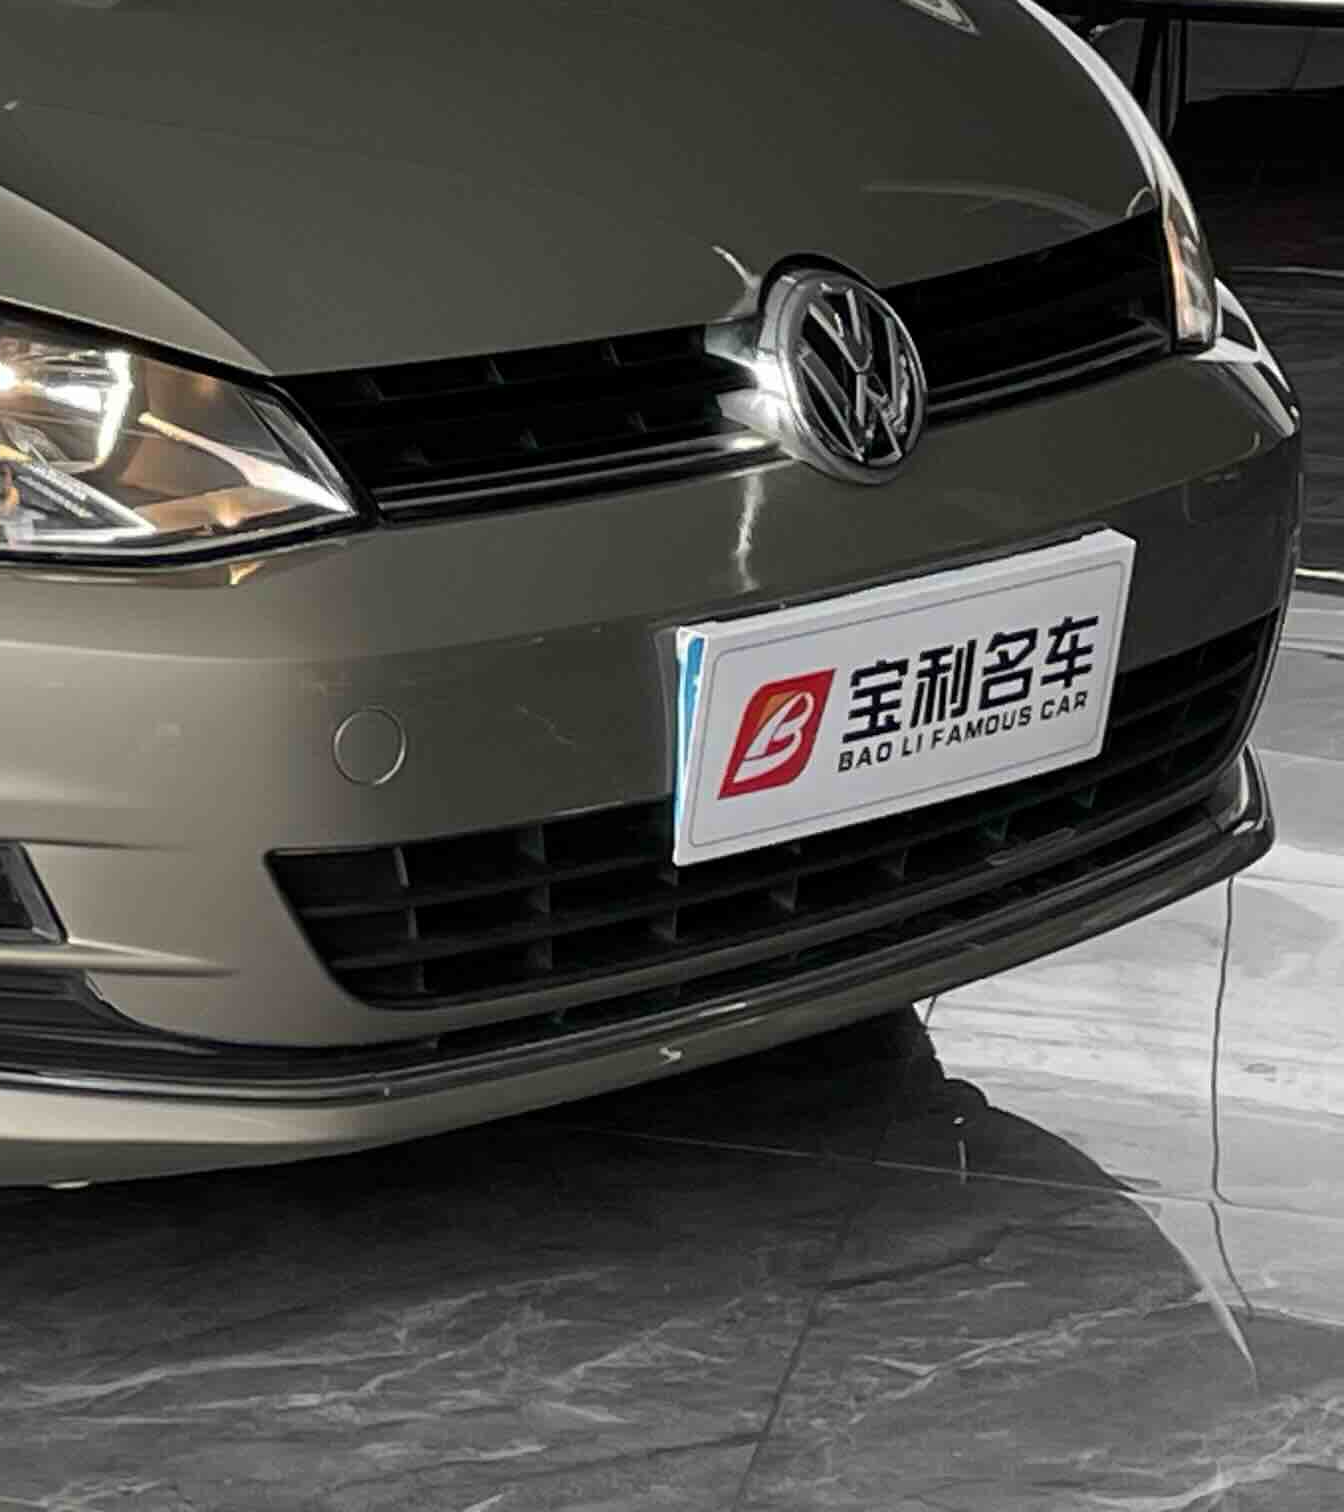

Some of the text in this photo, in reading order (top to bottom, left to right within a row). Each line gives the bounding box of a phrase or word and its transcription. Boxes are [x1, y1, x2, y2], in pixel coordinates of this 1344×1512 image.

[837, 690, 1089, 773] BAO LI FAMOUS CAR
[842, 615, 1099, 745] 宝利名车
